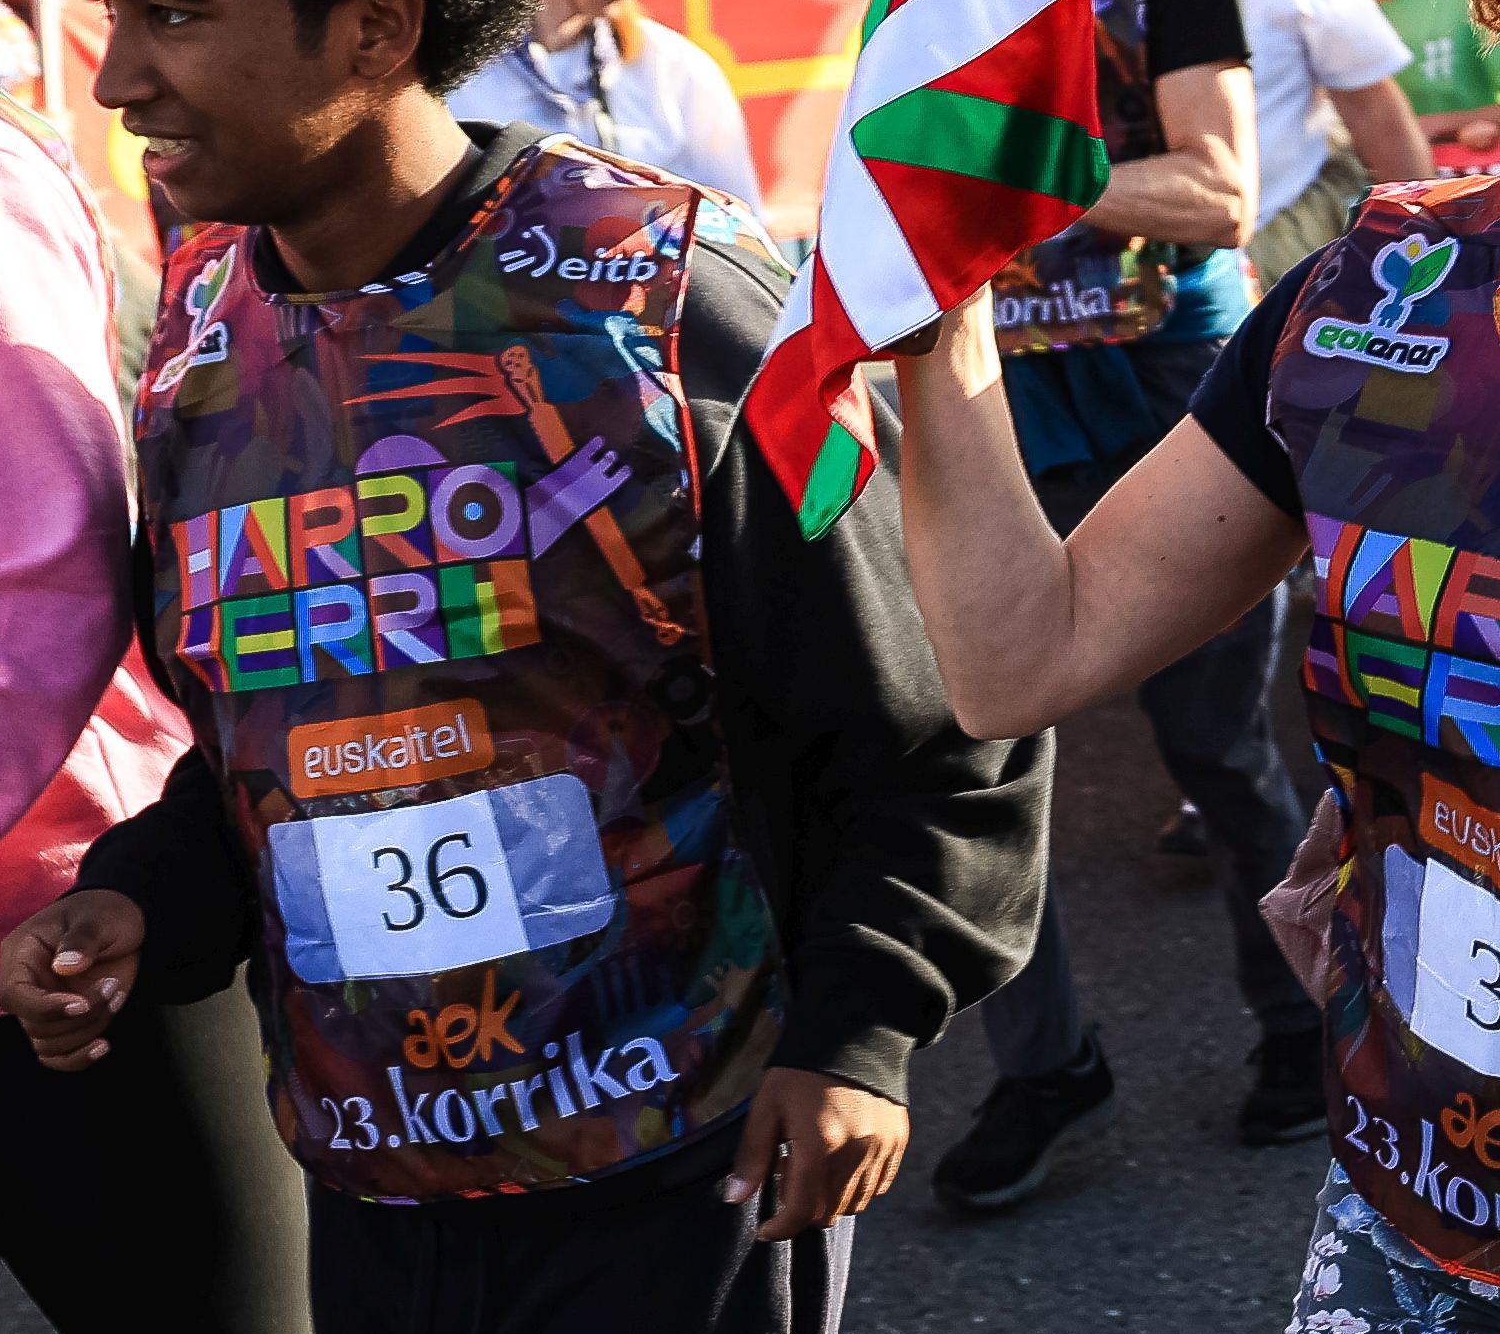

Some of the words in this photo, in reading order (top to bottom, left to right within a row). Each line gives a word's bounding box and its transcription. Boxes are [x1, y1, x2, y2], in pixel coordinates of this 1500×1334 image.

[557, 247, 659, 282] eitb
[994, 279, 1111, 329] orrika
[1316, 324, 1442, 366] goiener
[304, 714, 474, 779] euskaltel
[370, 832, 490, 932] 36
[404, 970, 527, 1069] aek
